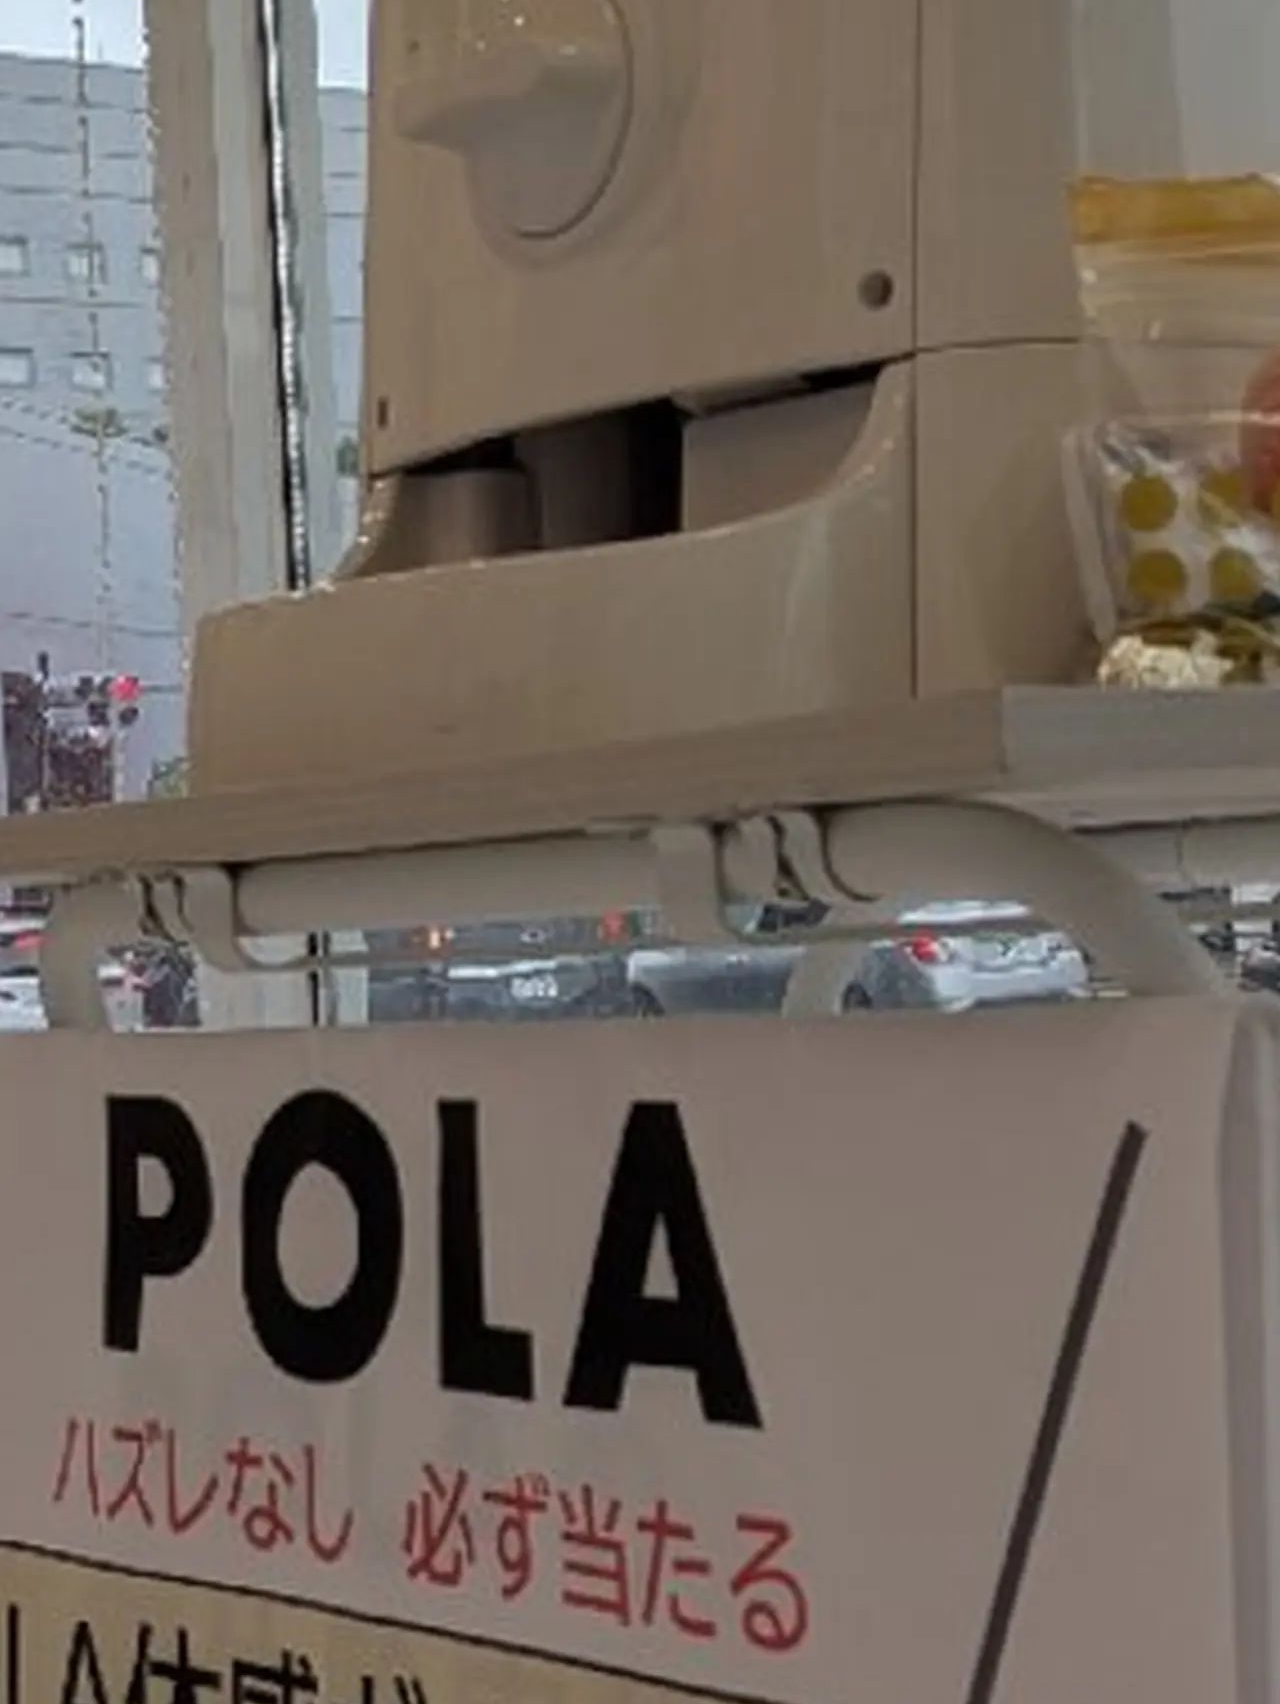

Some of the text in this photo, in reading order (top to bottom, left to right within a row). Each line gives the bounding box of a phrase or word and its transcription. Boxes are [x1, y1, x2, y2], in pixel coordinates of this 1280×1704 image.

[103, 1088, 763, 1429] POLA
[54, 1417, 810, 1652] ハズレなし 必ず当たる
